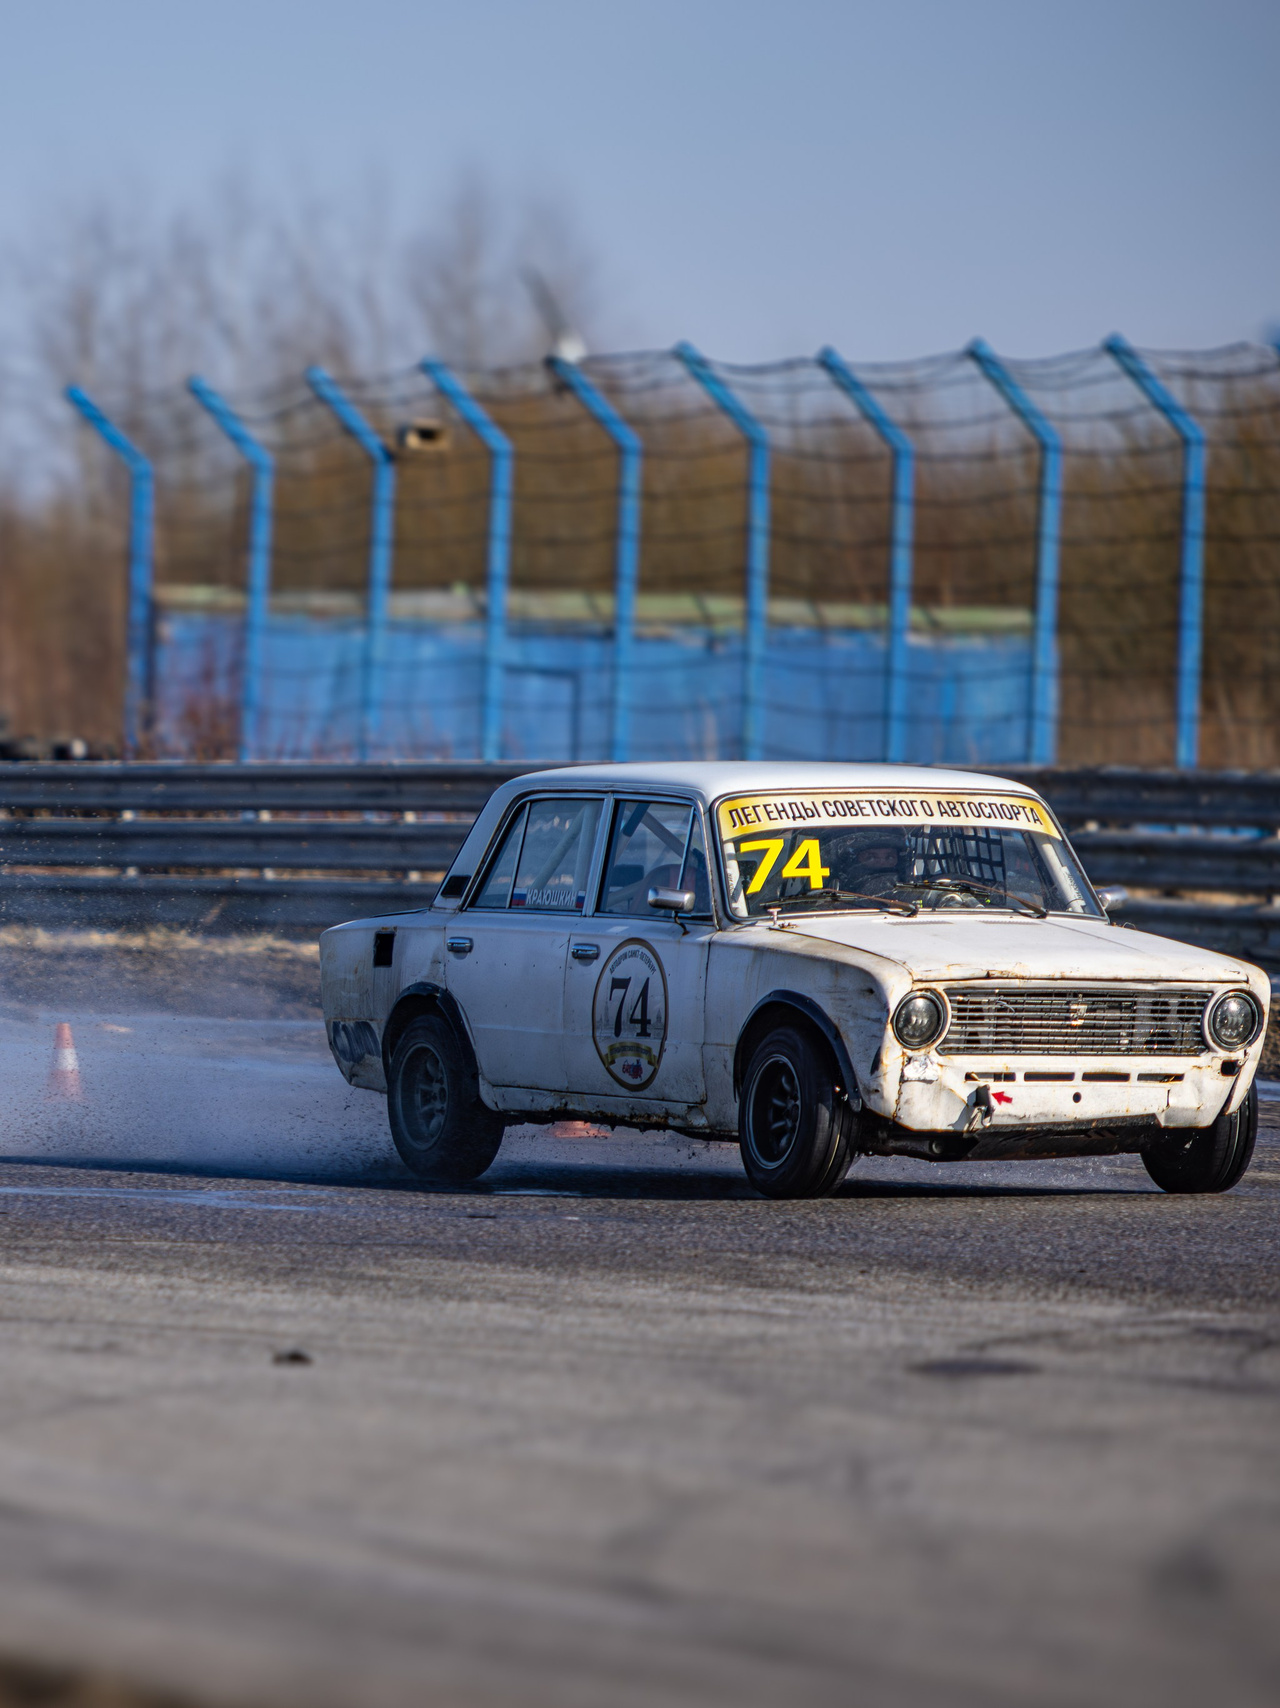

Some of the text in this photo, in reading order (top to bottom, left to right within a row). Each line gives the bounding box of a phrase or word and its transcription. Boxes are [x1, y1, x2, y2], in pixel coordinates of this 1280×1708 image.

[728, 799, 1043, 828] ЛЕГЕНДЫ СОВЕТСКОГО АВТОСПОРТА
[740, 838, 830, 895] 74
[526, 889, 577, 906] КРАЮШКИН
[609, 976, 651, 1037] 74
